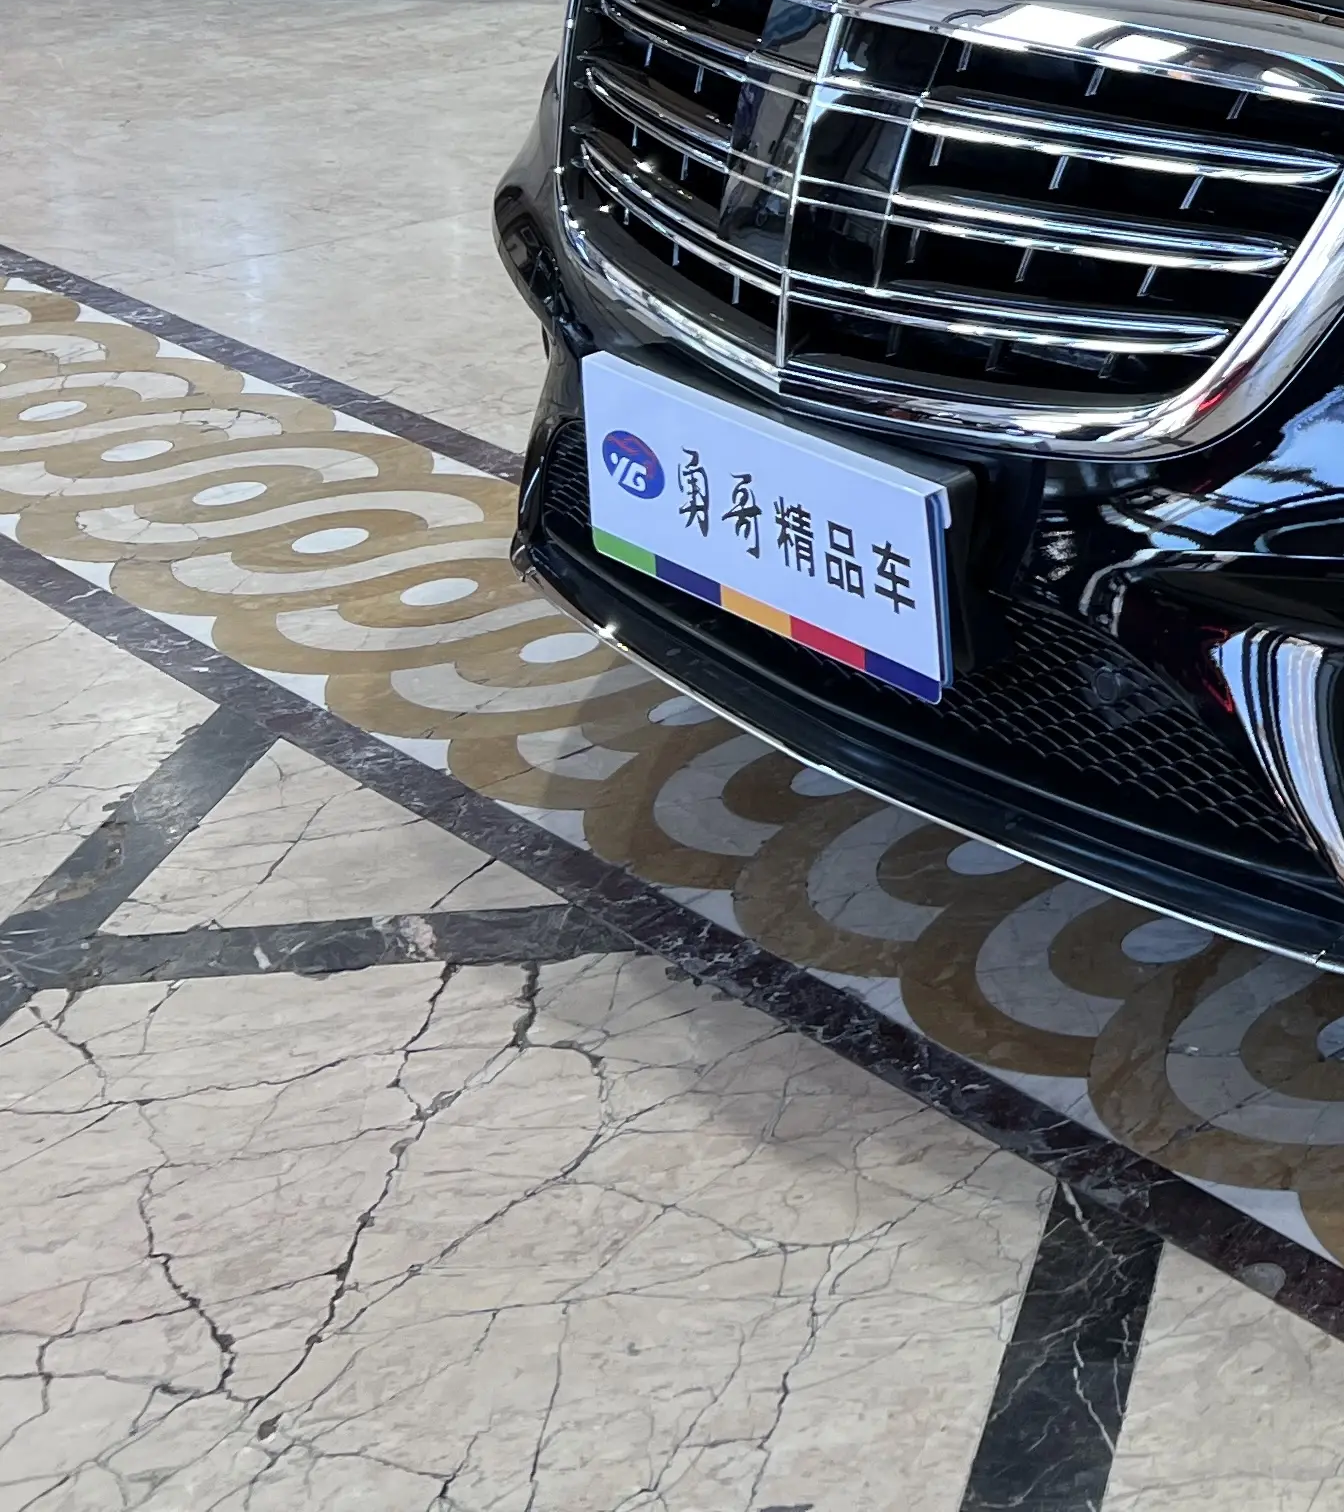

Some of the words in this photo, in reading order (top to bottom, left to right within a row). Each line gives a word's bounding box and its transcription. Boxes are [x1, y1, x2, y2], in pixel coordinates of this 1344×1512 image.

[676, 445, 917, 615] 勇哥精品车
